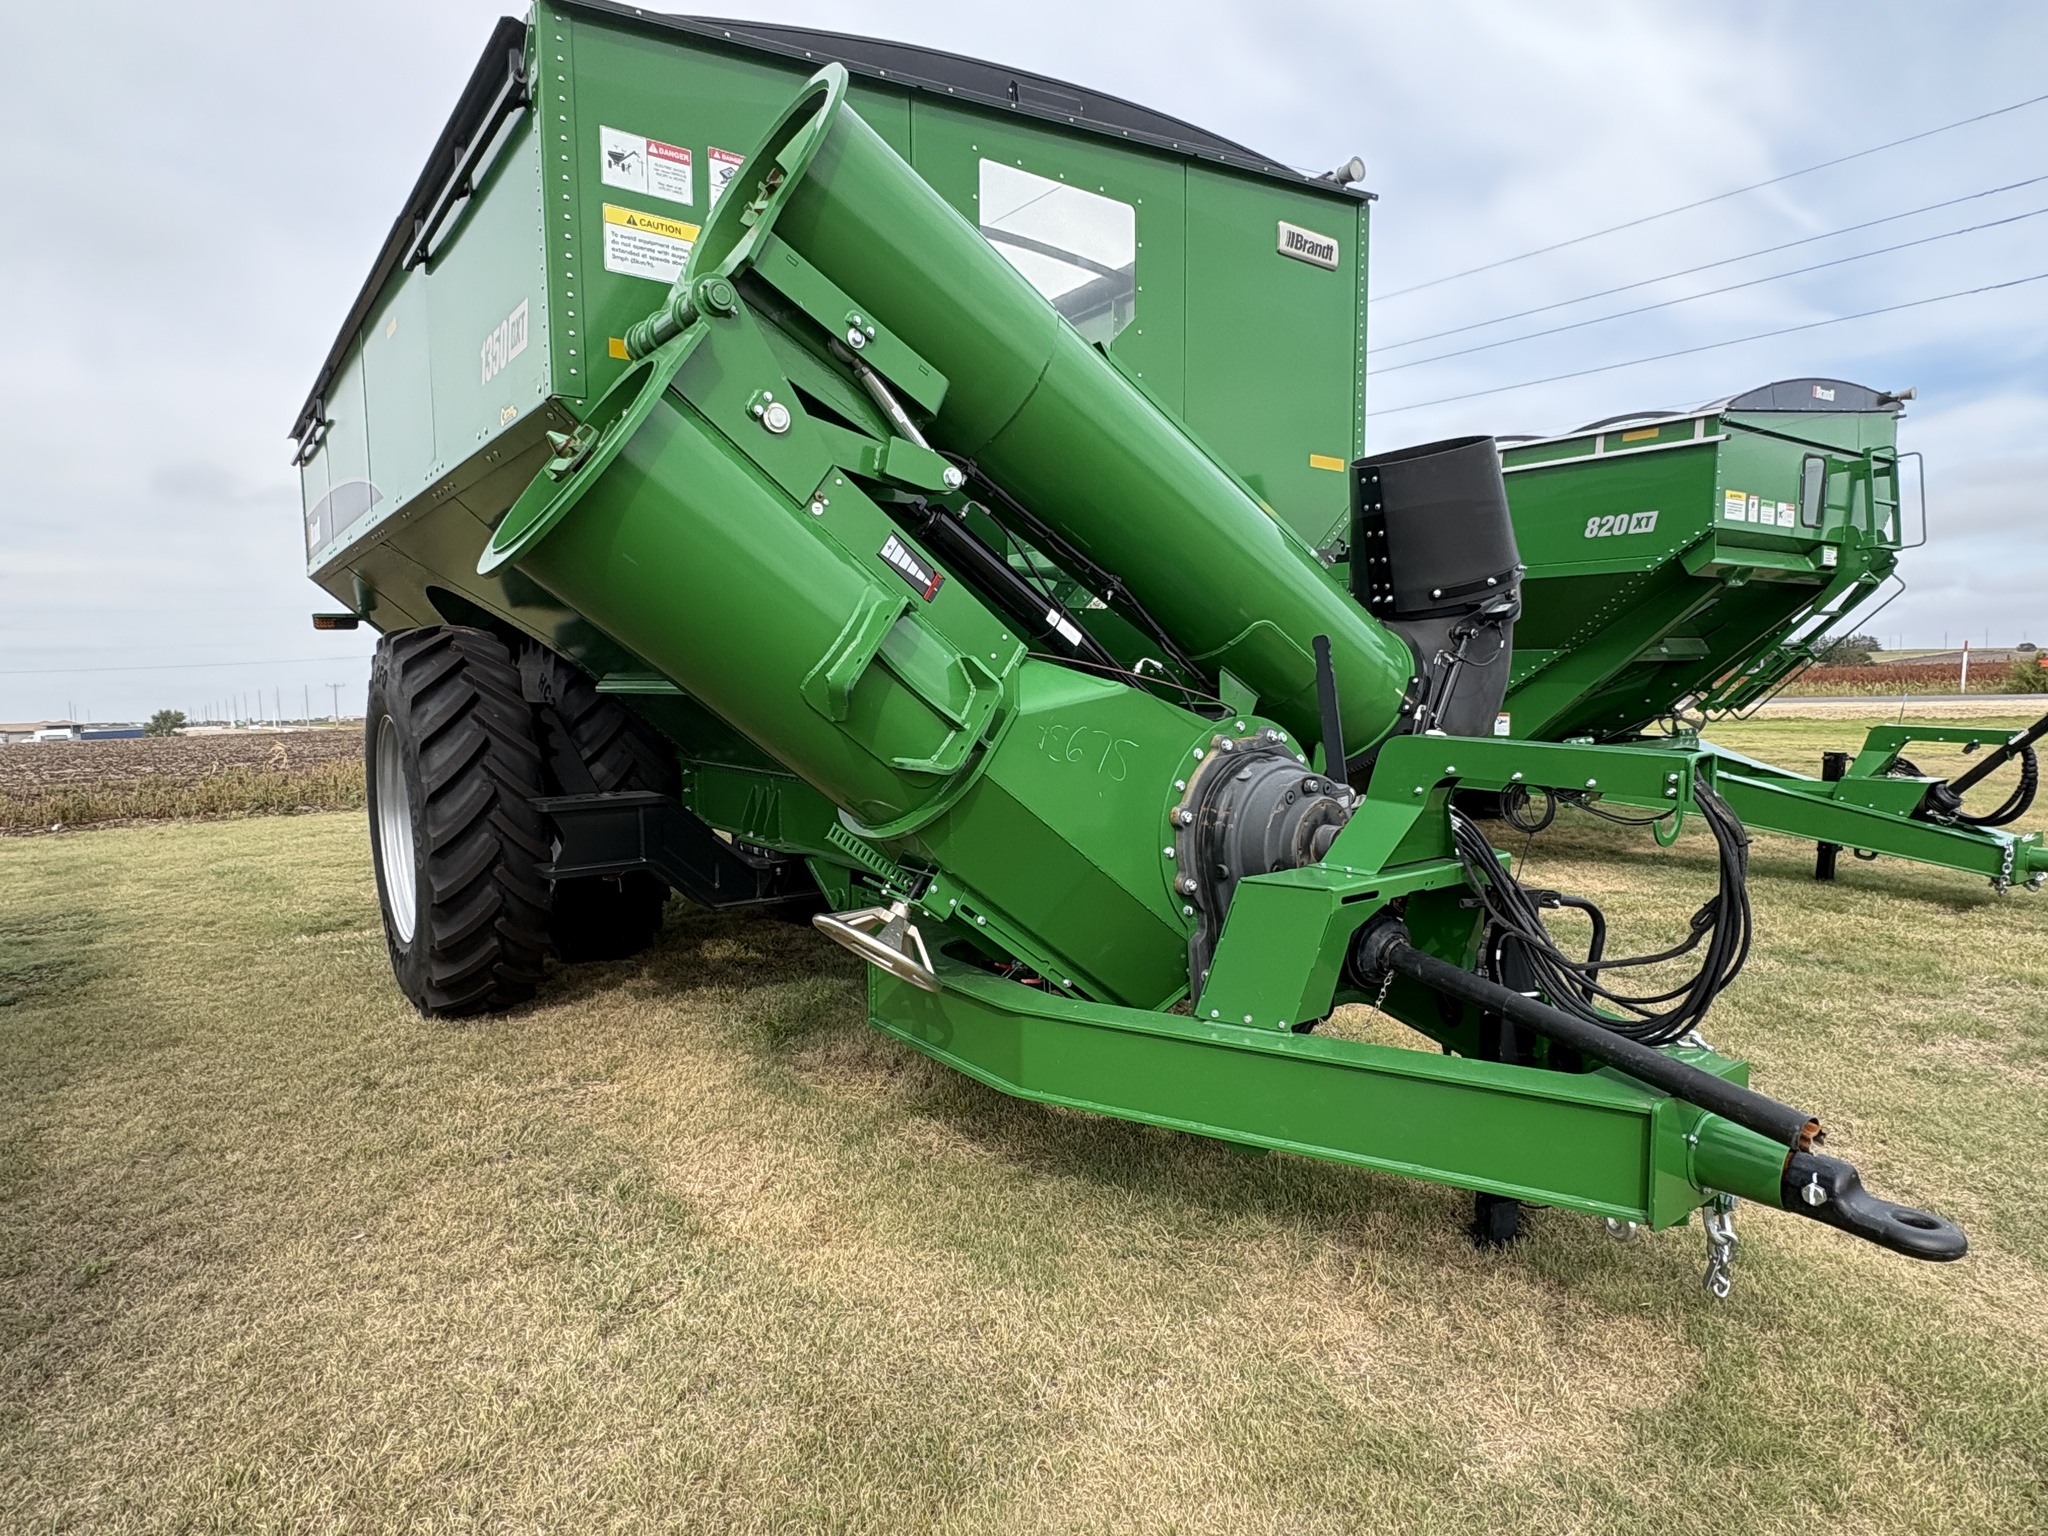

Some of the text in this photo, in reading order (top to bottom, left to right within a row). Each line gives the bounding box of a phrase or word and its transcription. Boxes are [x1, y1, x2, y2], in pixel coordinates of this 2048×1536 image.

[658, 147, 690, 162] DANGER
[639, 218, 682, 235] CAUTION
[611, 230, 619, 238] To
[620, 234, 637, 242] avoid
[638, 238, 670, 250] equipment
[632, 244, 656, 253] operate
[1293, 232, 1334, 262] Brandt
[611, 247, 640, 257] extended
[649, 255, 670, 264] speeds
[481, 311, 526, 386] 1350 DXT
[1584, 513, 1654, 539] 820 XT
